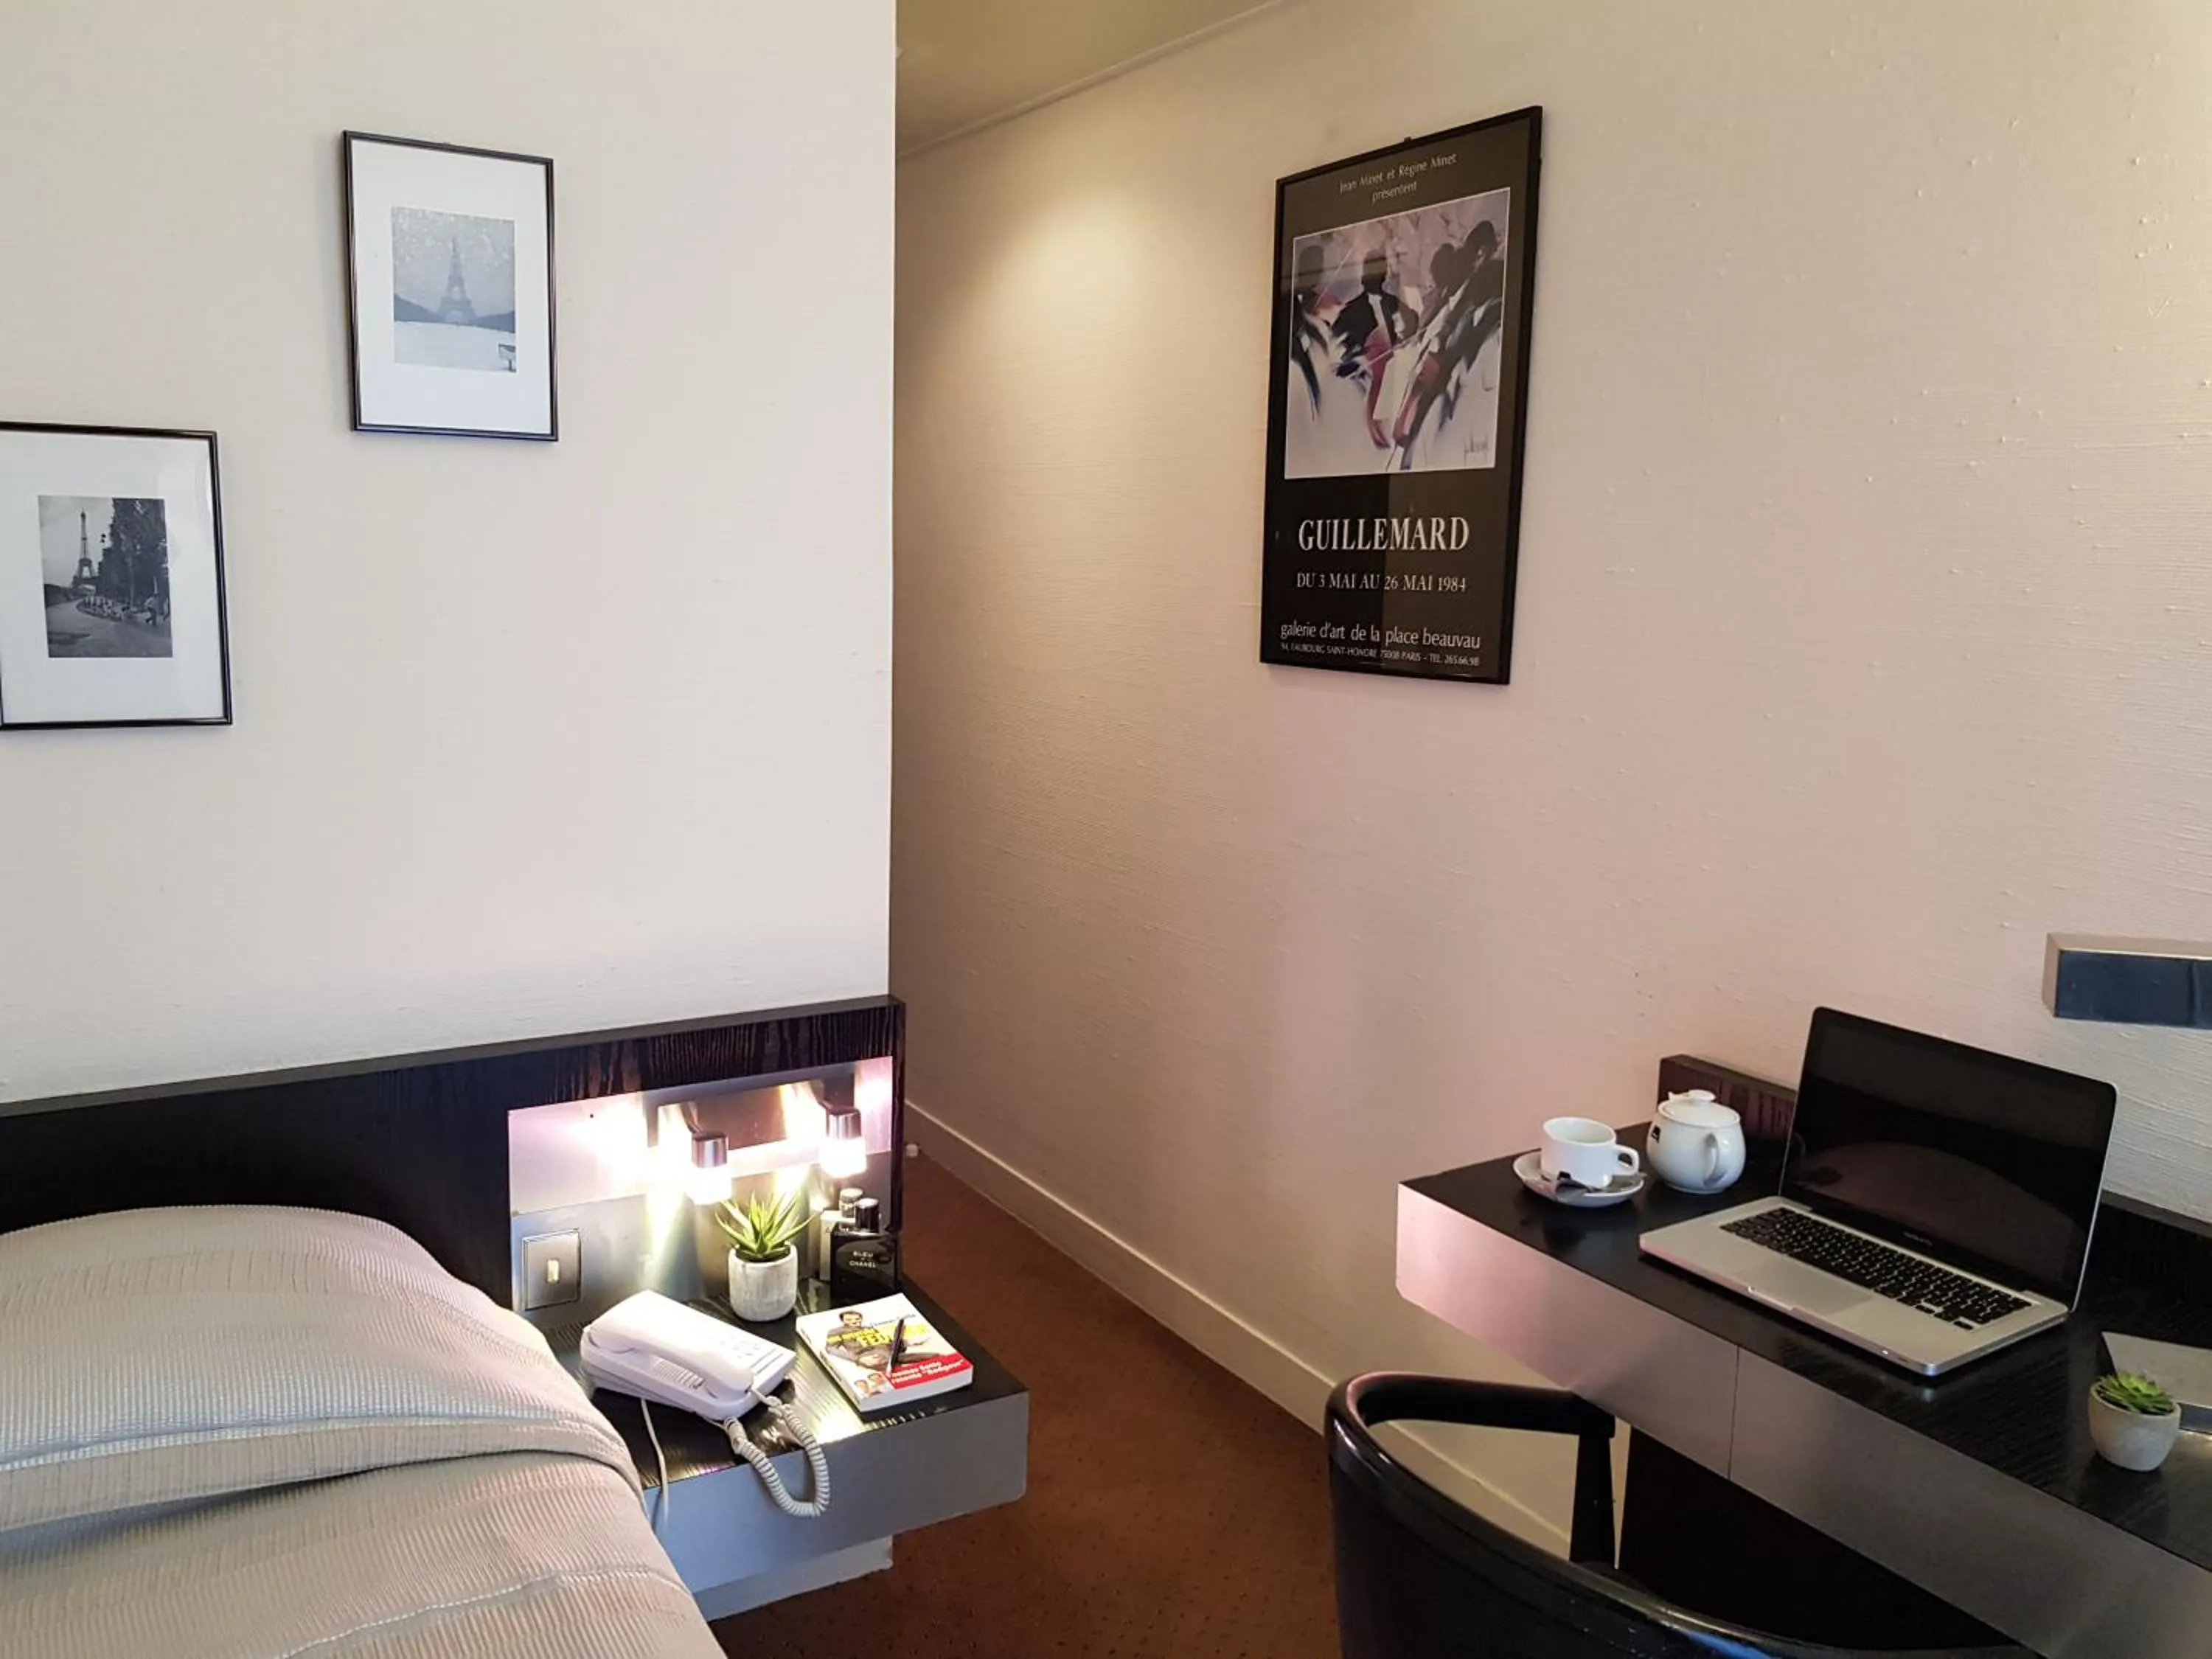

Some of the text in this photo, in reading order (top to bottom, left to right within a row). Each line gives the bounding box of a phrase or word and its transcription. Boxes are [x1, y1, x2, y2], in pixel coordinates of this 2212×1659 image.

[1386, 168, 1395, 180] et
[1430, 153, 1458, 169] Minet
[1298, 516, 1470, 552] GUILLEMARD
[1297, 572, 1467, 592] DU 3 MAI AU 26 MAI 1984
[1280, 619, 1481, 650] galerie d'art de la place beauvau
